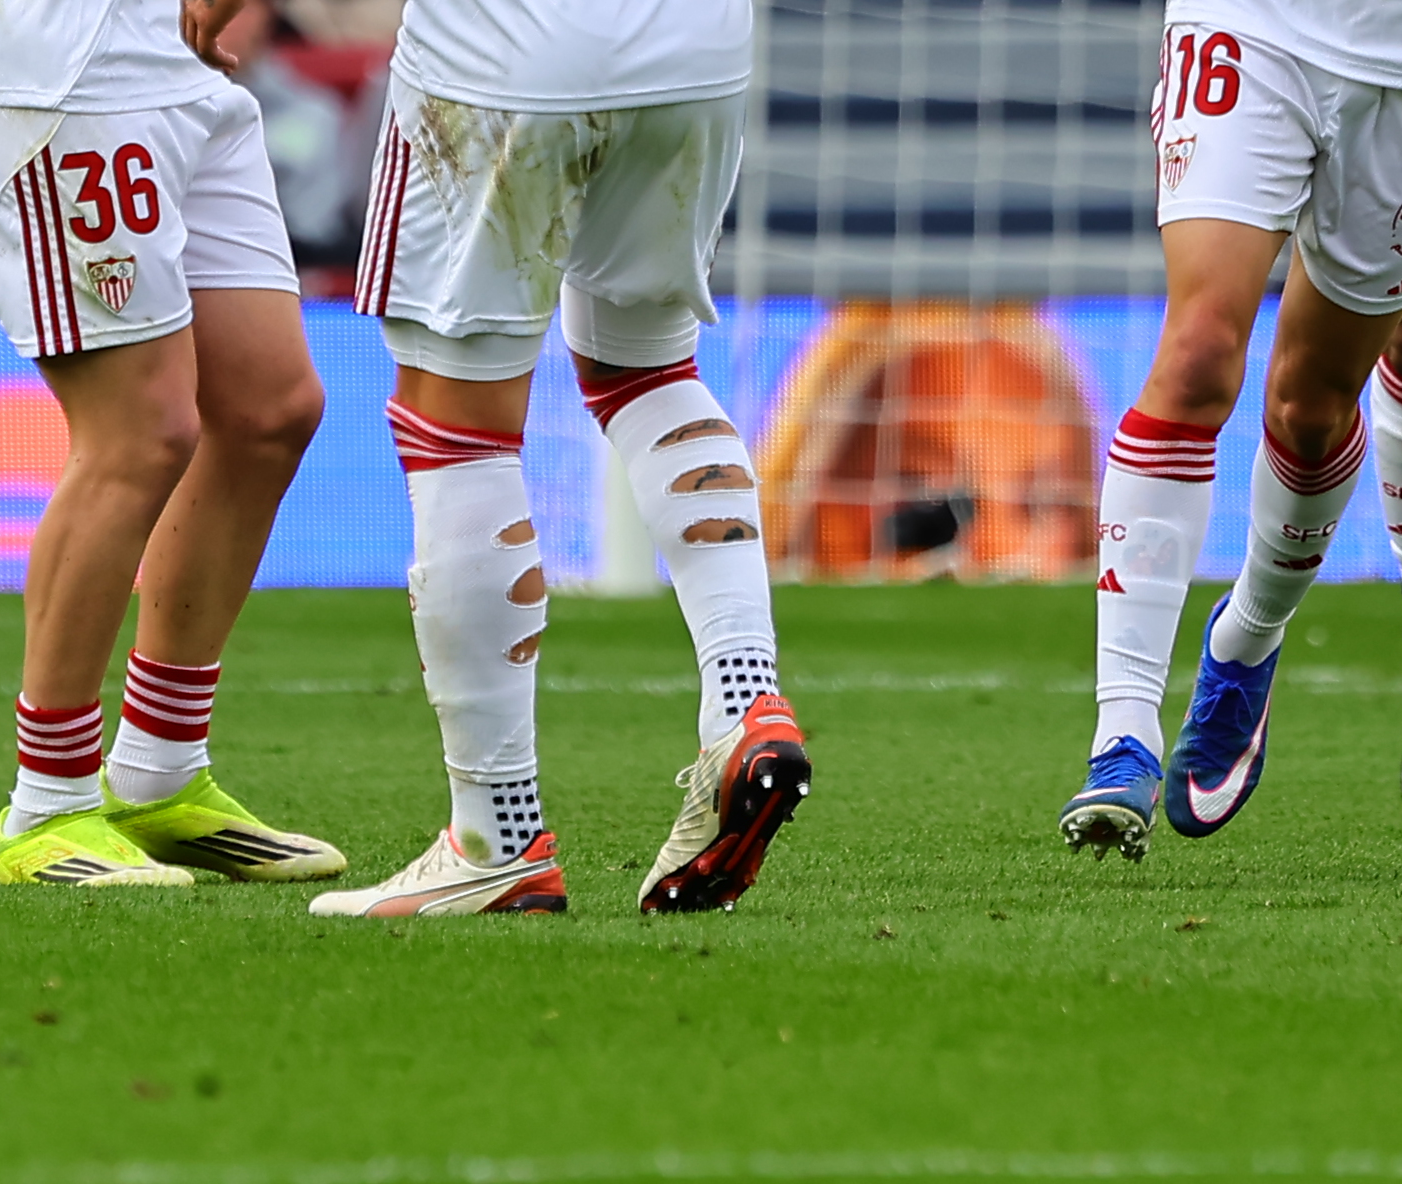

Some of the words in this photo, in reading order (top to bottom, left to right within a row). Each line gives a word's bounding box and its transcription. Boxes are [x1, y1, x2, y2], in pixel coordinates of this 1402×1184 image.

[1173, 31, 1242, 120] 16
[58, 142, 161, 244] 36
[1097, 523, 1127, 541] FC
[1281, 520, 1337, 543] SFC
